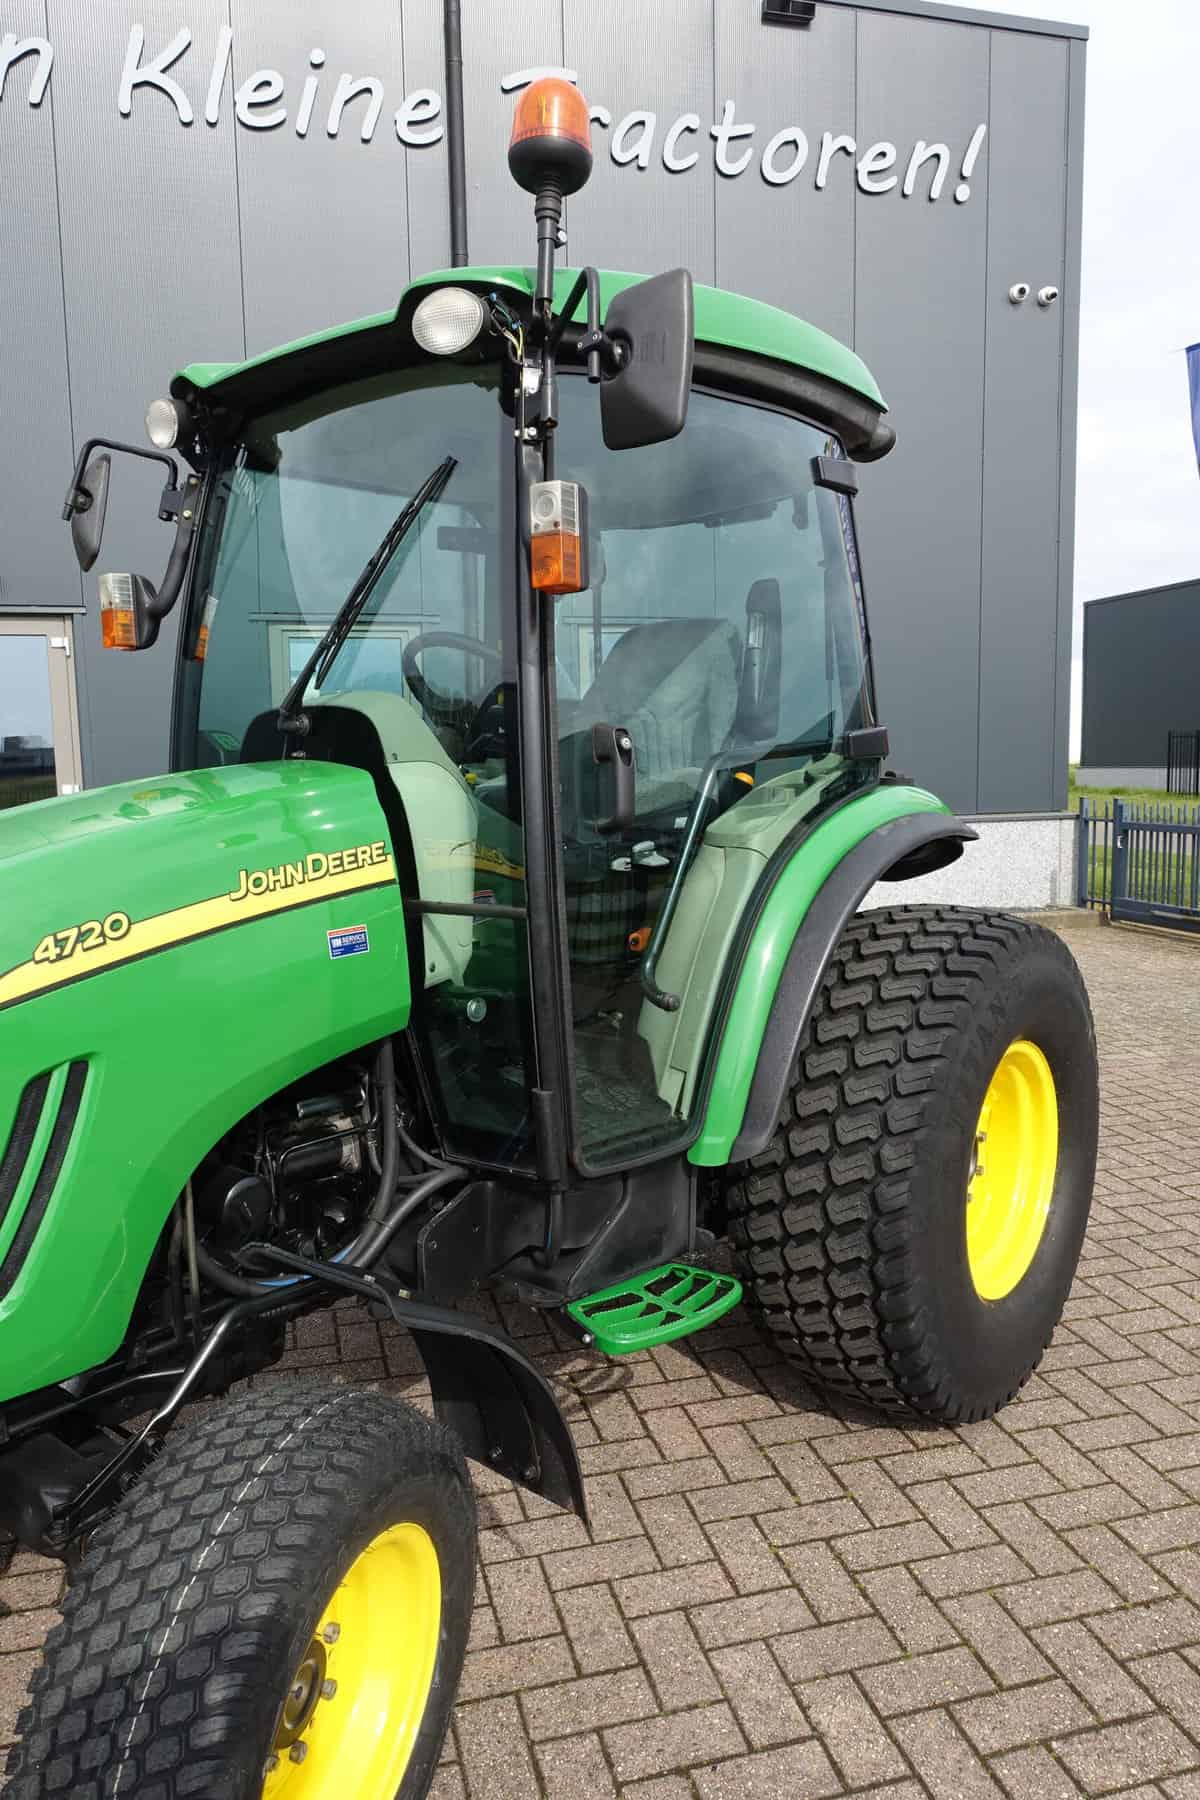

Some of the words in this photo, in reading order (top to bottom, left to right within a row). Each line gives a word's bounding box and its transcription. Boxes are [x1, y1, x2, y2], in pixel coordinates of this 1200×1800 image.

[117, 24, 444, 146] Kleine
[230, 861, 304, 901] JOHN
[306, 841, 387, 881] DEERE
[33, 911, 131, 964] 4720
